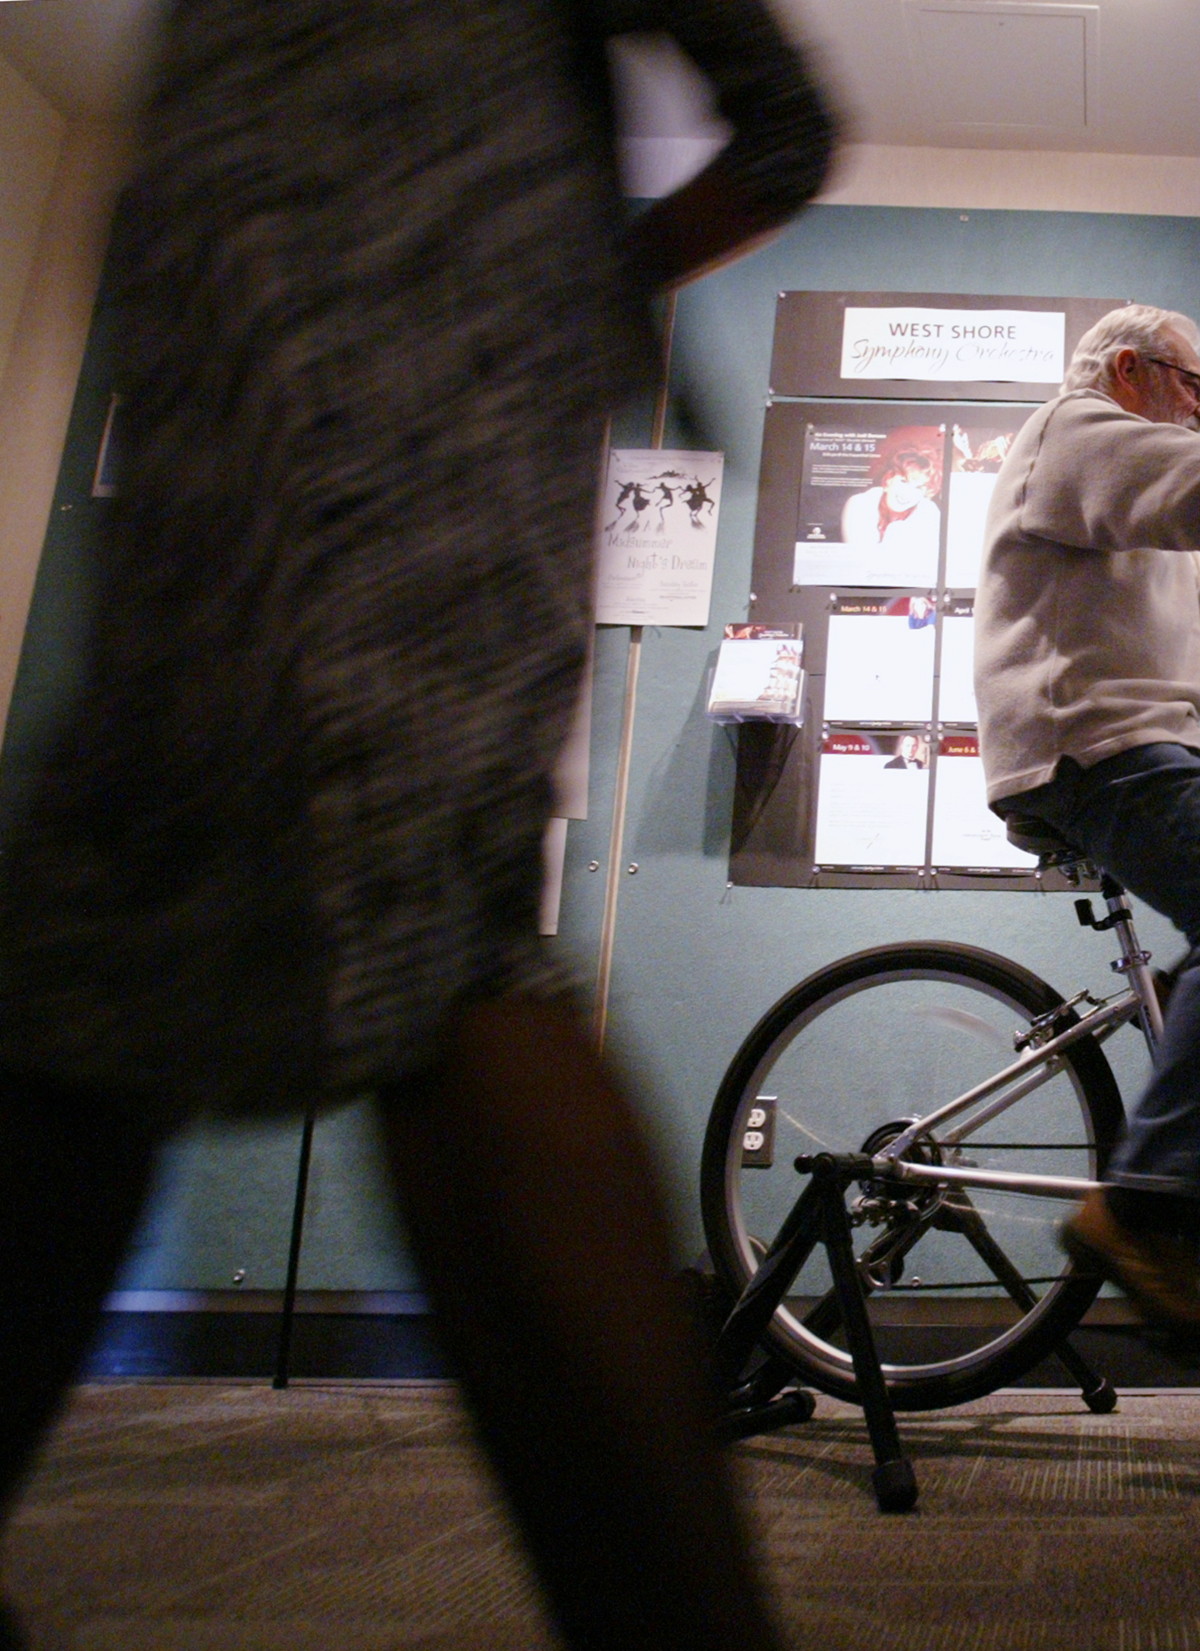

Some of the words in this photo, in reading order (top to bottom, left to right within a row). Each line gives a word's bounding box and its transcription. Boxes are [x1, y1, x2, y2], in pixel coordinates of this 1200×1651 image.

[888, 322, 945, 338] WEST
[950, 325, 1017, 340] SHORE
[850, 338, 950, 374] Symphony
[810, 443, 839, 451] March
[865, 444, 876, 452] 15
[607, 532, 671, 549] Midsummer
[627, 552, 669, 577] Night's
[671, 555, 708, 571] Dream
[833, 744, 847, 752] May
